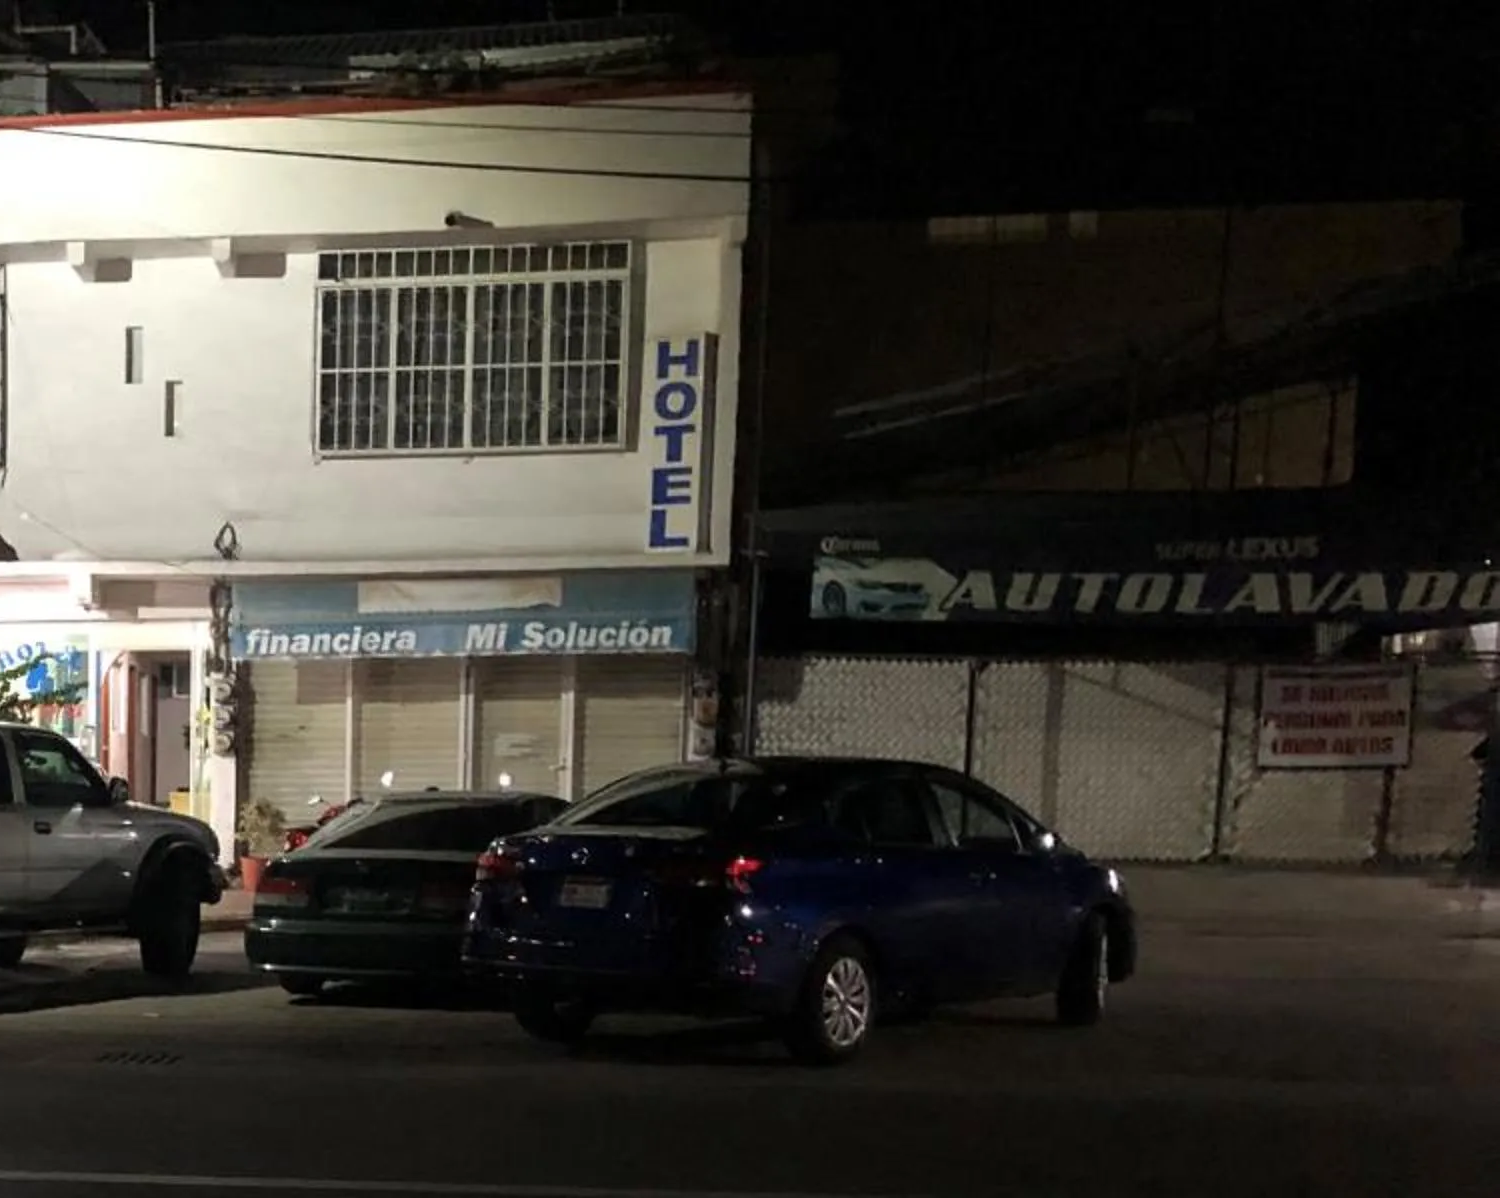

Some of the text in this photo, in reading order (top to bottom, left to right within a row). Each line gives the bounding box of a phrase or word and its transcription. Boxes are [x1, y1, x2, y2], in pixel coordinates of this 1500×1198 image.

[649, 338, 700, 548] HOTEL
[1223, 535, 1321, 560] LEXUS
[938, 569, 1500, 615] AUTOLAVADO
[245, 618, 673, 655] financiera Mi Solución
